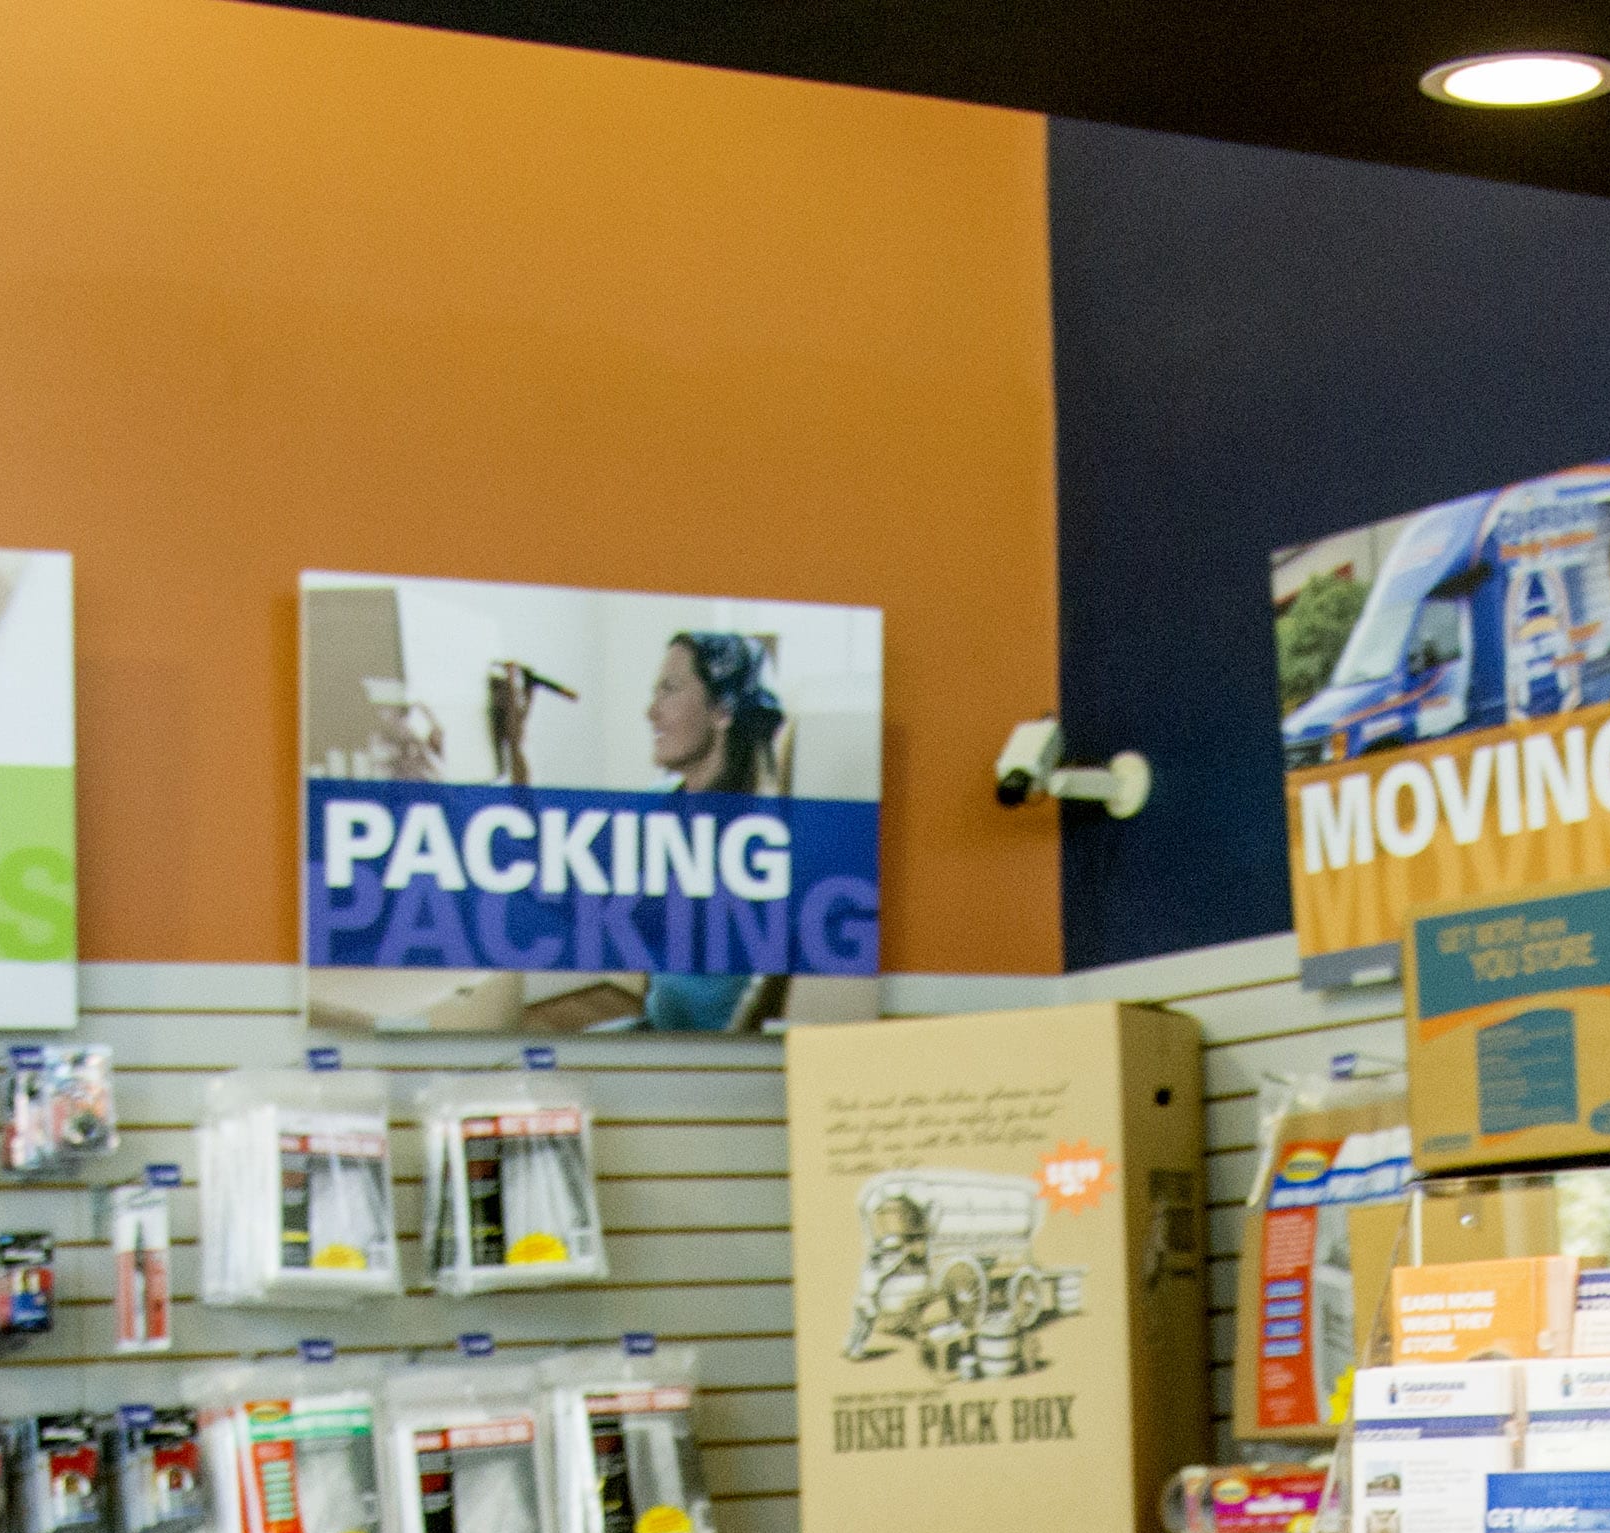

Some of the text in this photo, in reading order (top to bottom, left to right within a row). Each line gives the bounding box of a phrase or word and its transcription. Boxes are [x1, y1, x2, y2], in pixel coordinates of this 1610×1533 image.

[324, 799, 792, 900] PACKING
[833, 1394, 1077, 1453] DISH PACK BOX
[1487, 1506, 1579, 1528] GET MORE
